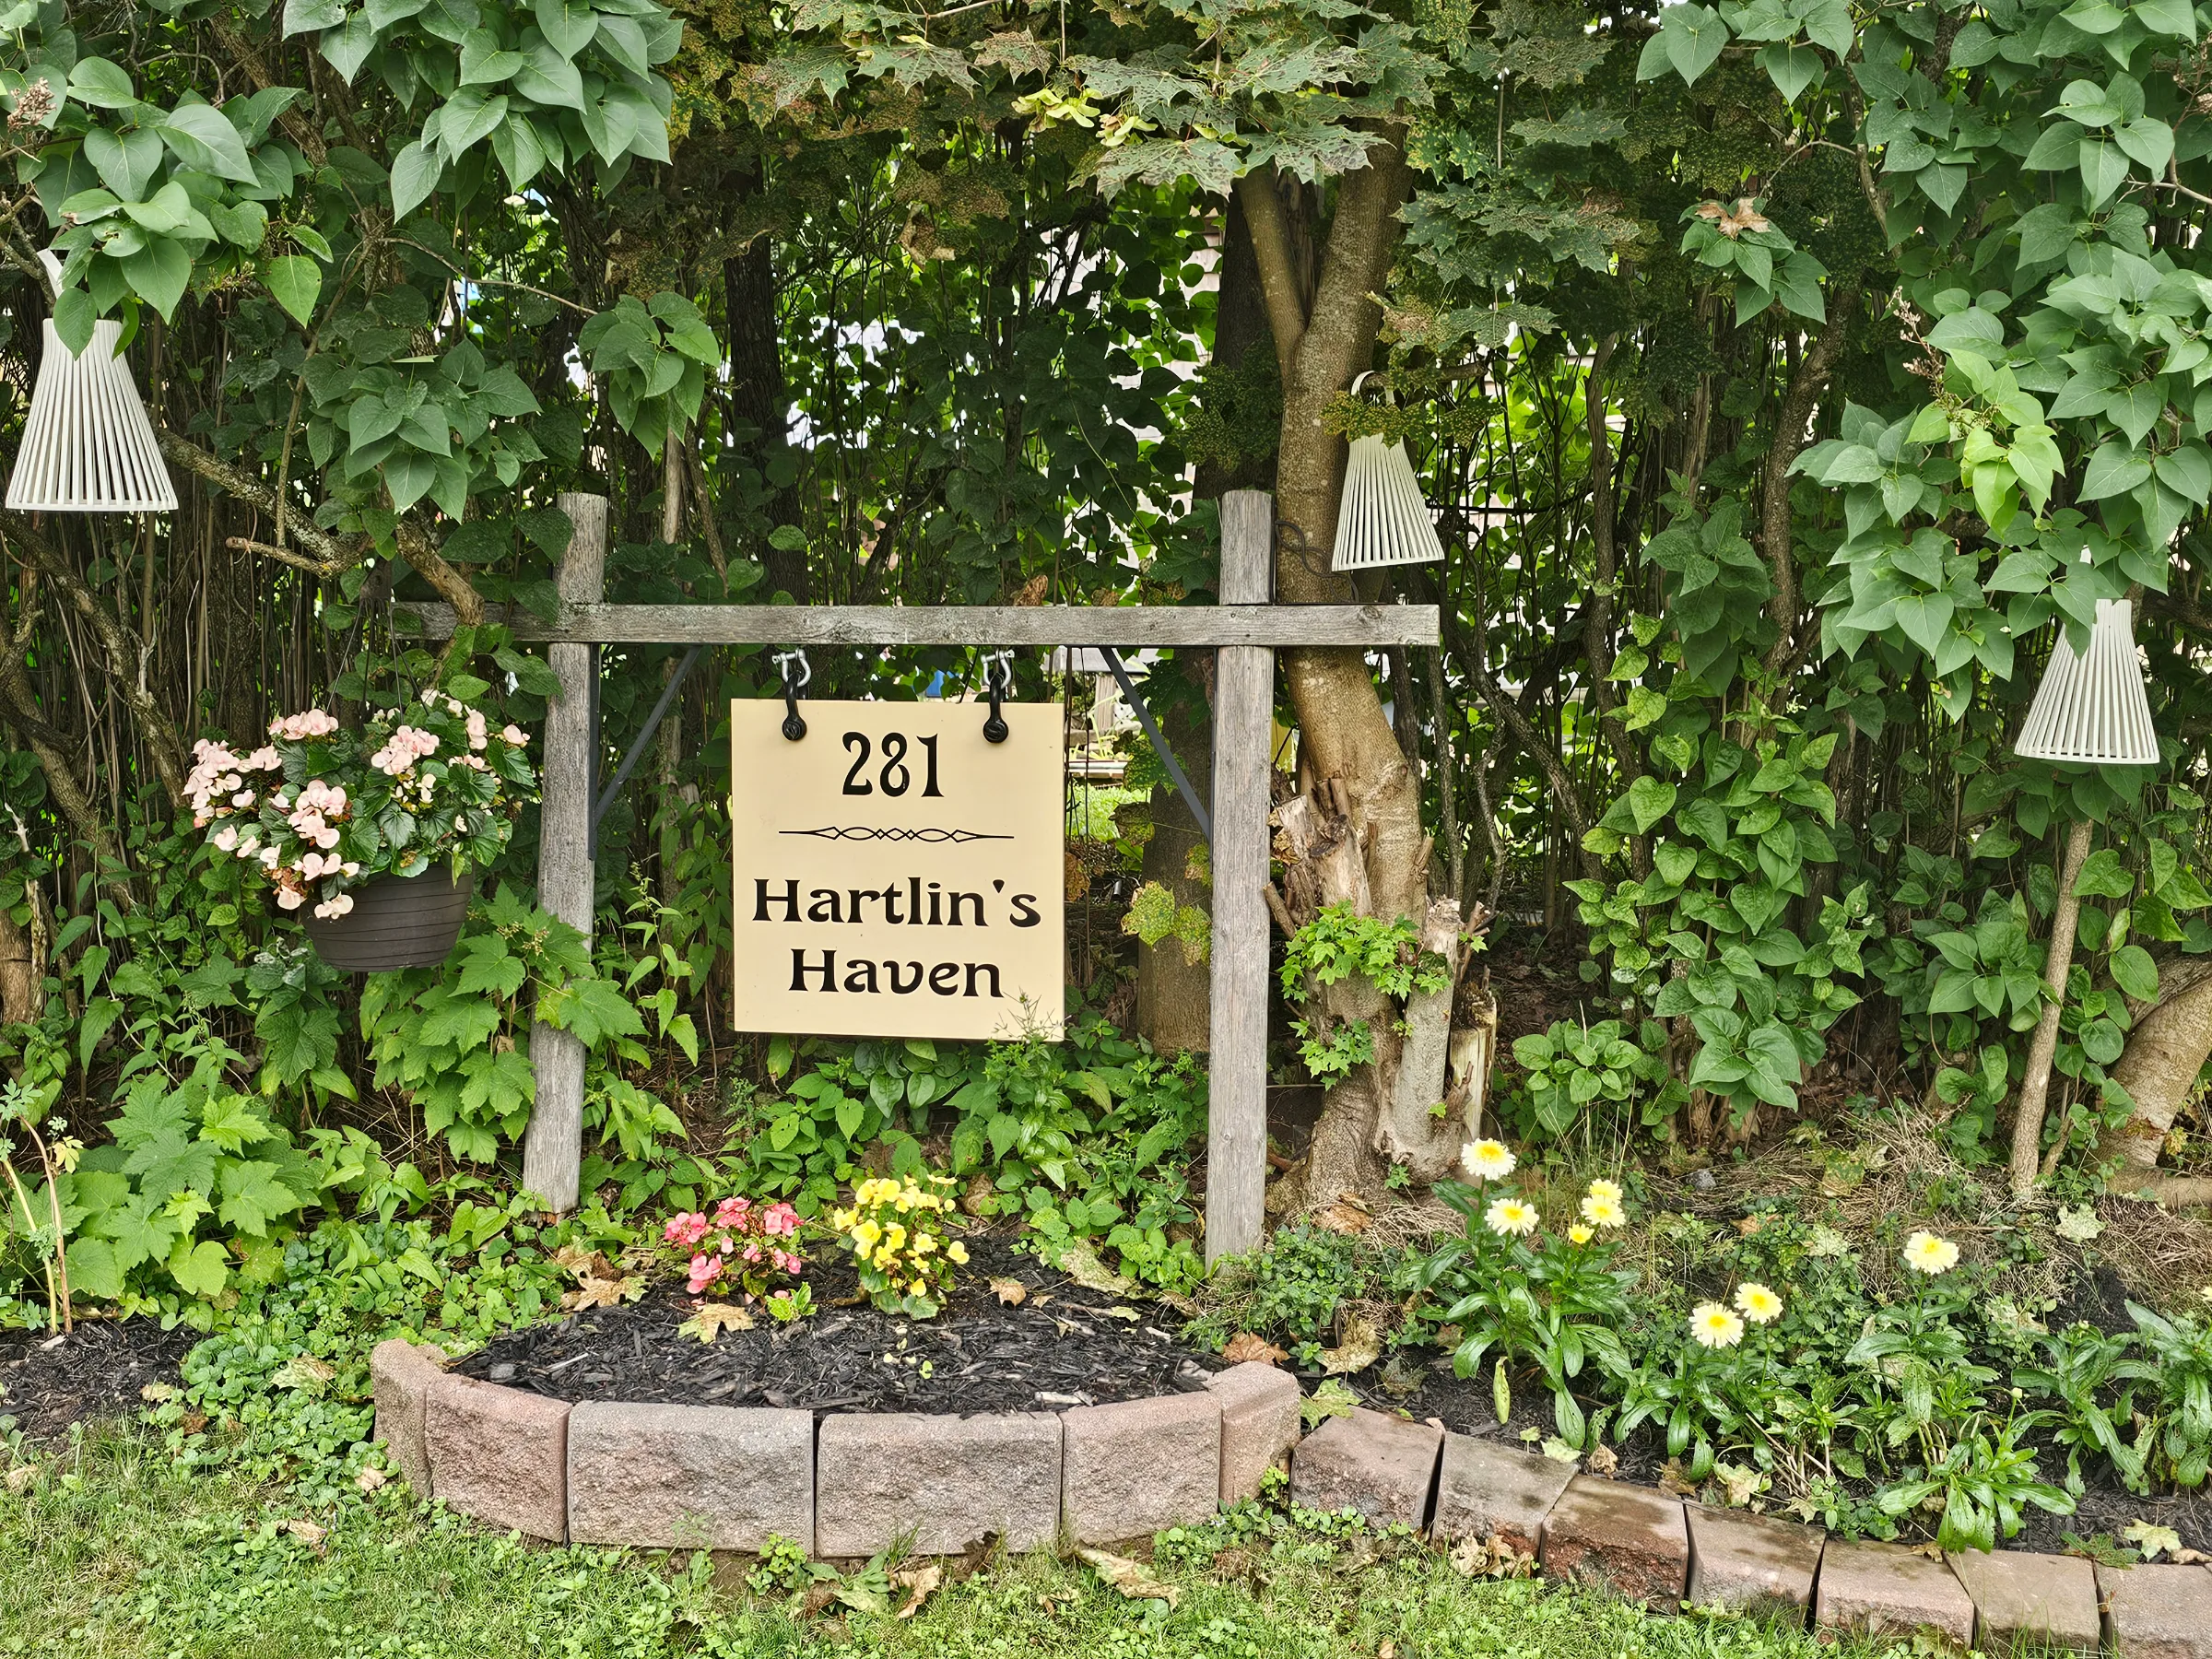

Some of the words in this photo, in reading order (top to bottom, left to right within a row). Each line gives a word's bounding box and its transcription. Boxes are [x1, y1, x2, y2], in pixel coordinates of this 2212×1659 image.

[841, 731, 944, 797] 281
[752, 877, 1041, 928] Hartlin's
[788, 948, 1004, 998] Haven
